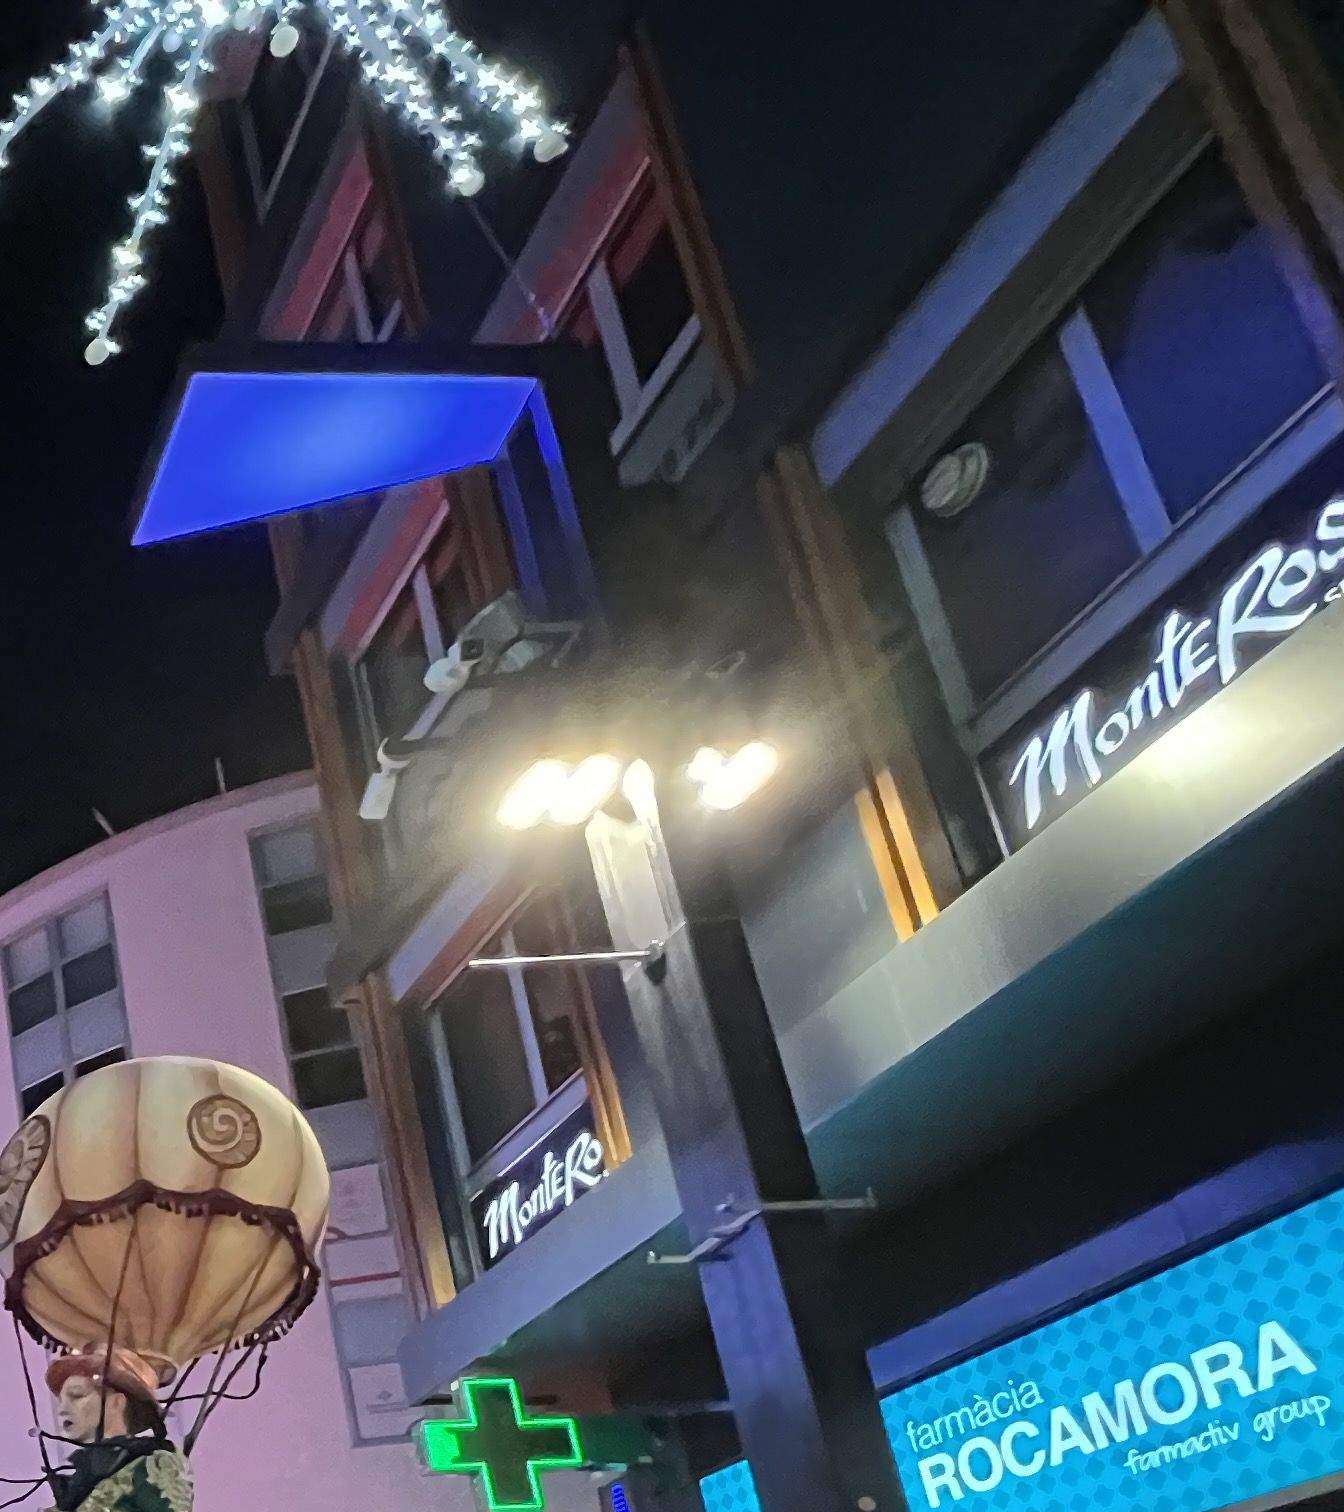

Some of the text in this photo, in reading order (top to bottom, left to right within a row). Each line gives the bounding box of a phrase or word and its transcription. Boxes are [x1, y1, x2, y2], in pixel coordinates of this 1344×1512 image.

[906, 1379, 1045, 1453] farmàcia
[916, 1320, 1318, 1509] ROCAMORA
[1123, 1394, 1331, 1475] farmactiv group
